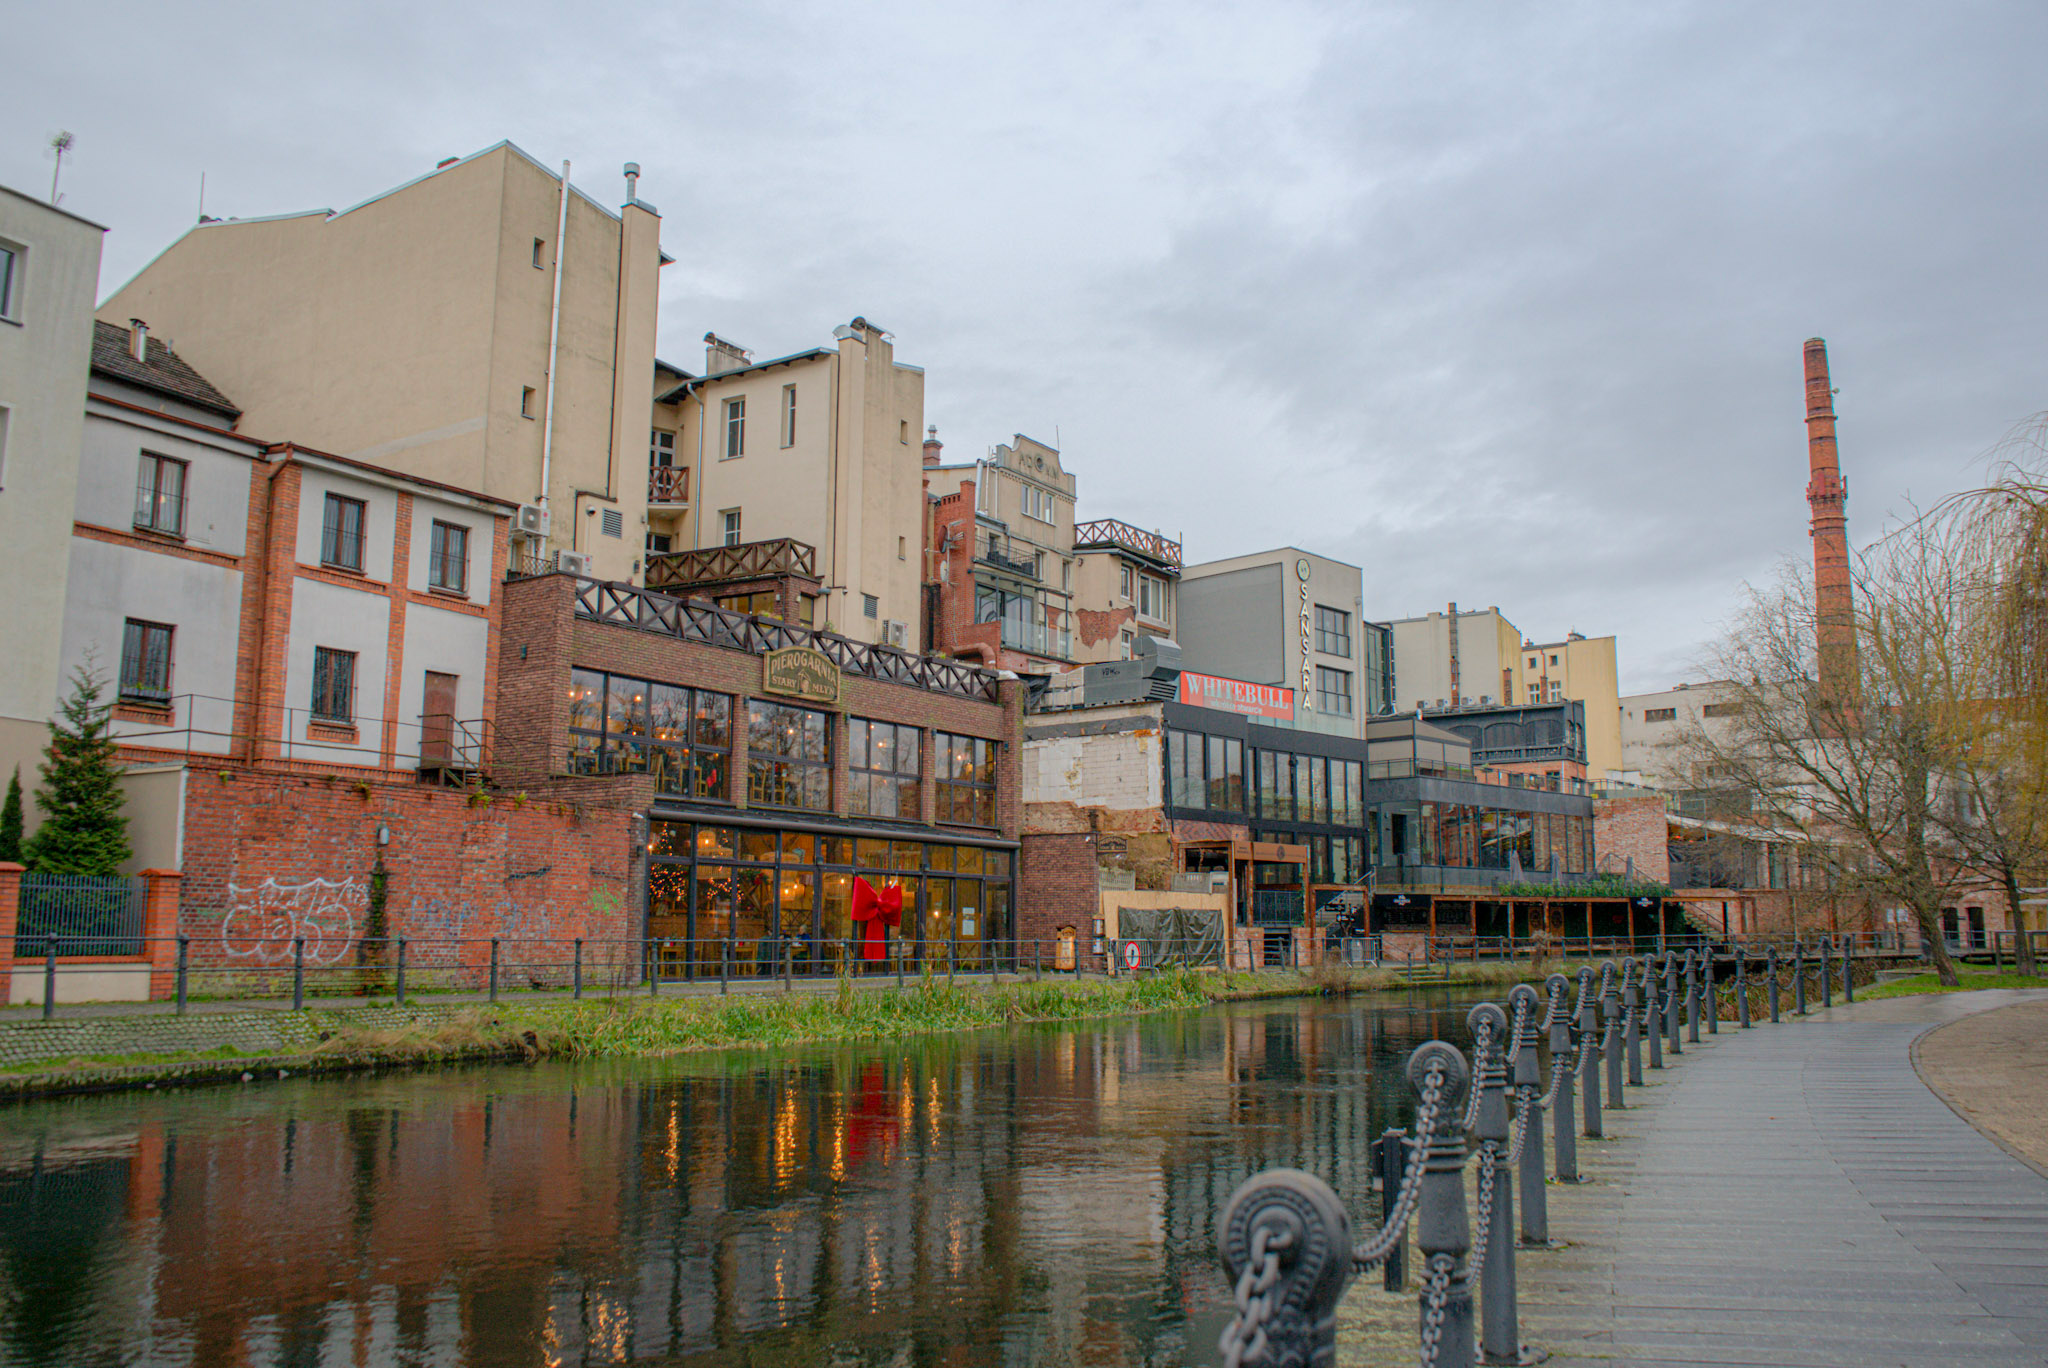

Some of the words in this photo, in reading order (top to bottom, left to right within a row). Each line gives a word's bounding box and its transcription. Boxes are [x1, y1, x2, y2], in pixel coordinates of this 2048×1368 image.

[1299, 583, 1312, 710] SANSARA
[771, 652, 837, 686] PIEROGARNIA
[772, 676, 797, 689] STARY
[1185, 673, 1288, 709] WHITEBULL
